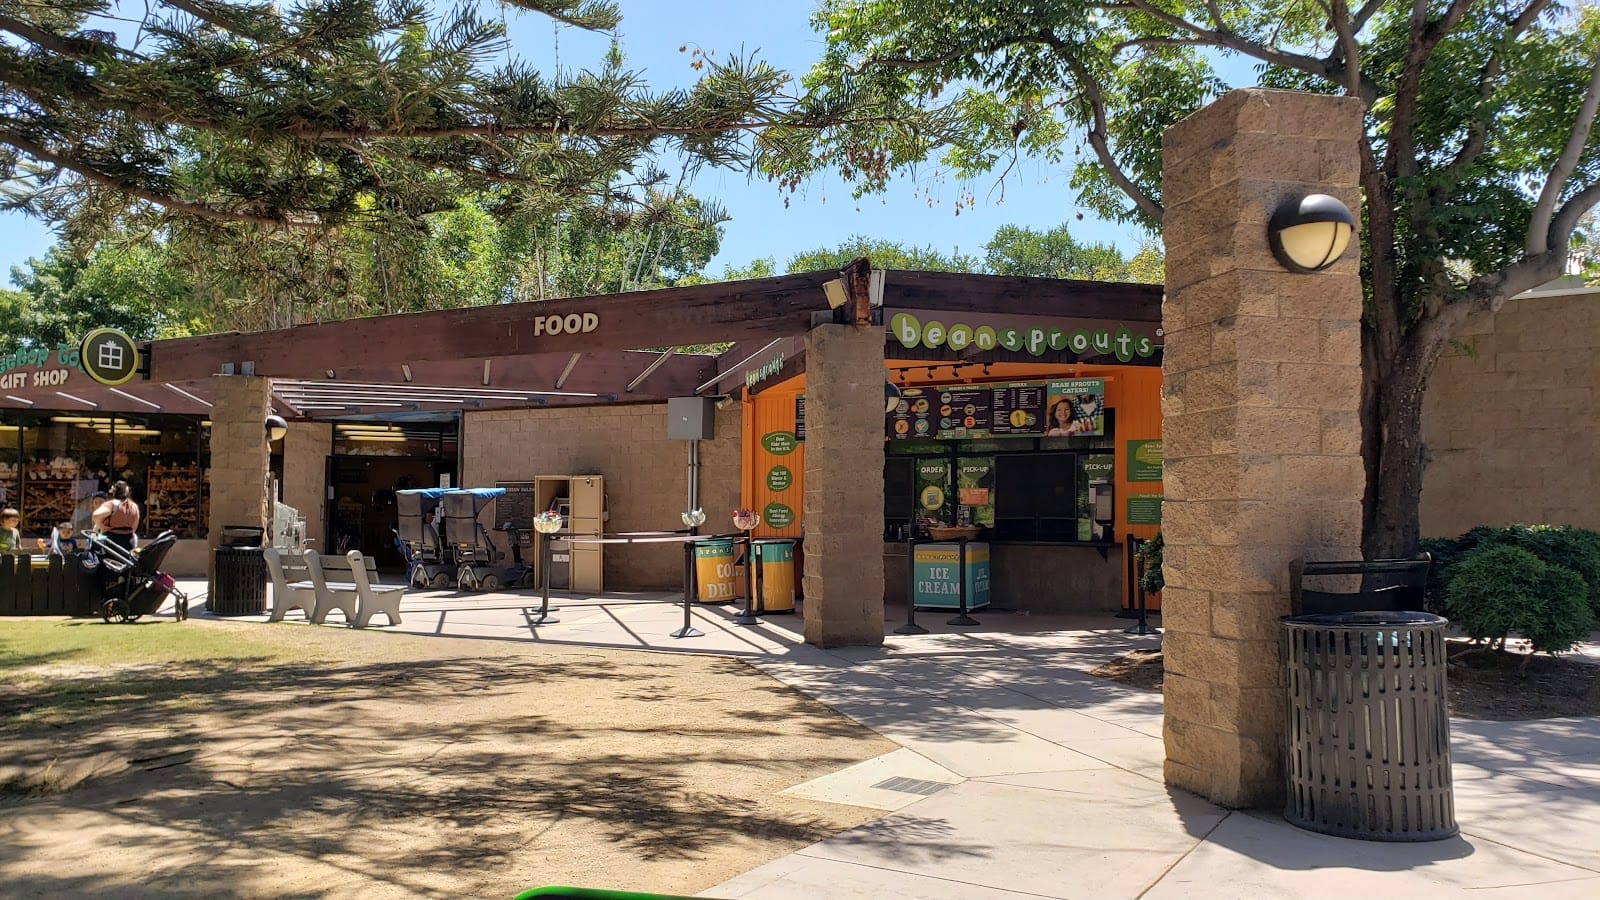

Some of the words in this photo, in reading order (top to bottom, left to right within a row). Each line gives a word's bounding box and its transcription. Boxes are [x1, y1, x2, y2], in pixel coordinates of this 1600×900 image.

[534, 312, 599, 337] FOOD
[896, 314, 1153, 360] beansprouts
[1, 372, 27, 389] GIFT
[33, 369, 69, 387] SHOP
[920, 466, 944, 474] ORDER
[1084, 463, 1113, 471] PICK-UP
[929, 567, 950, 579] ICE
[918, 581, 961, 594] CREAM
